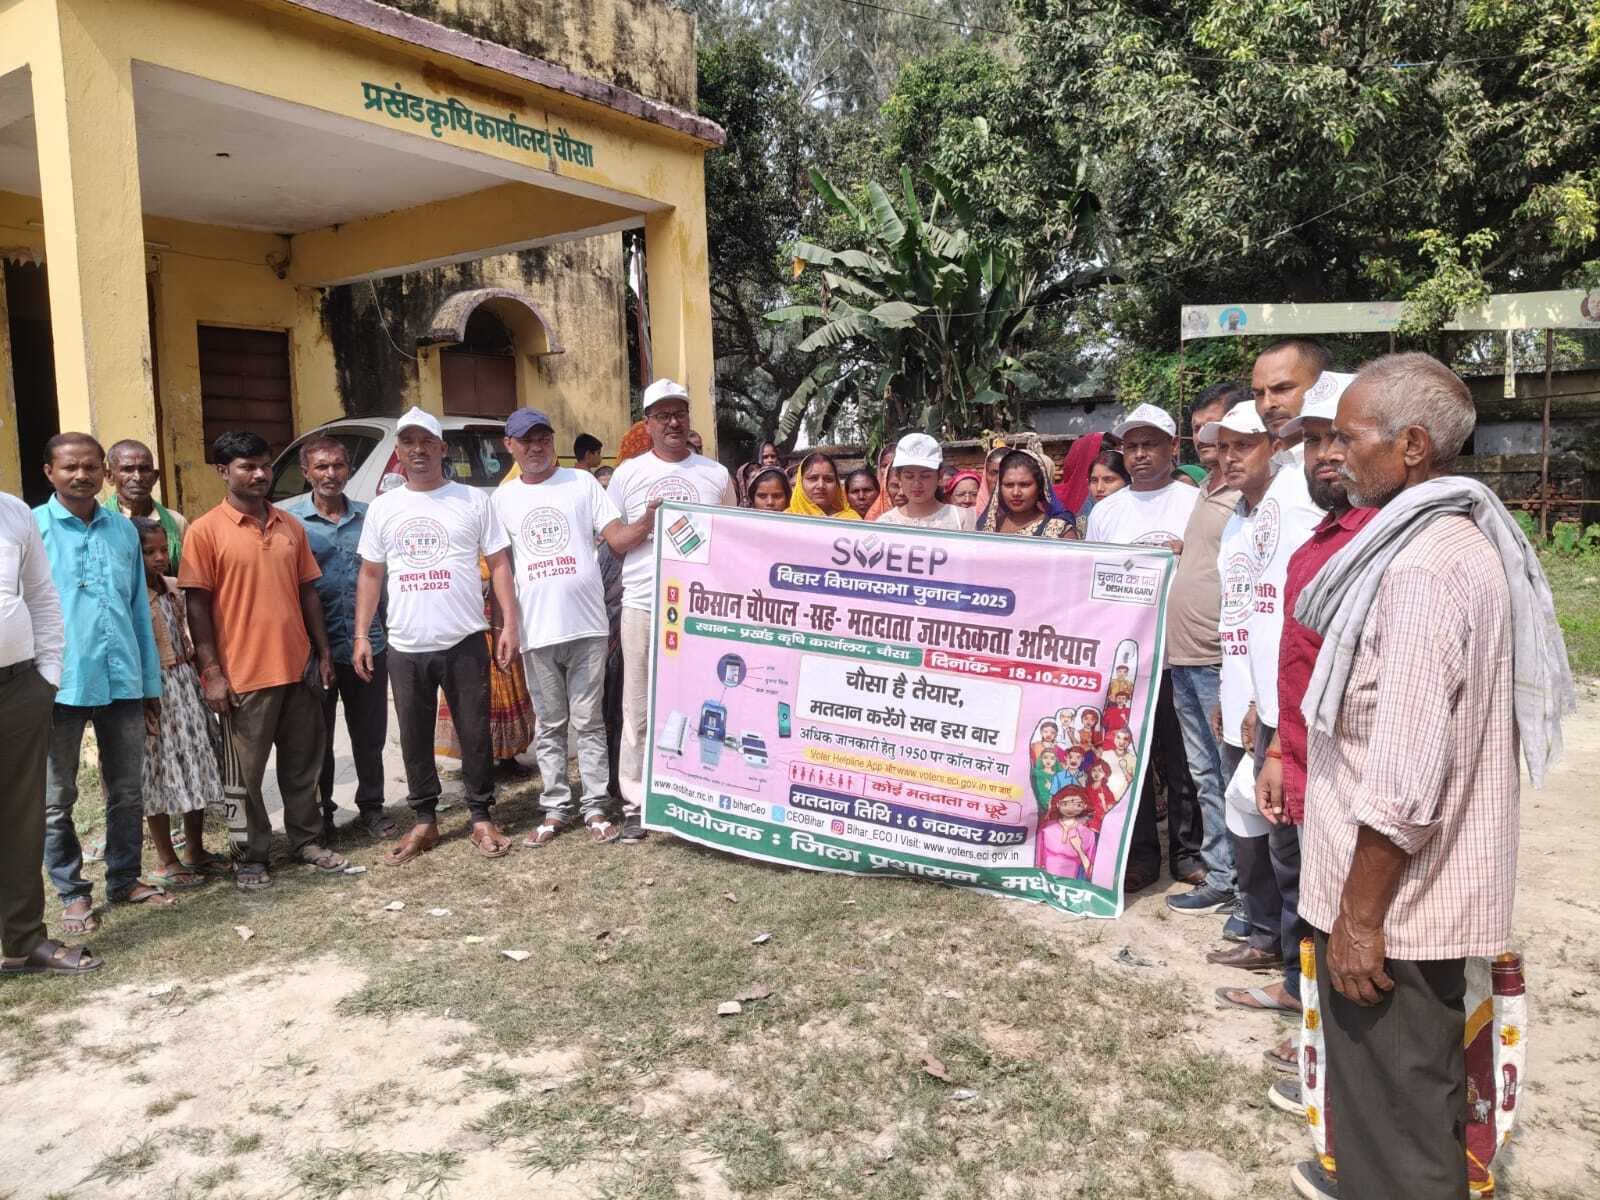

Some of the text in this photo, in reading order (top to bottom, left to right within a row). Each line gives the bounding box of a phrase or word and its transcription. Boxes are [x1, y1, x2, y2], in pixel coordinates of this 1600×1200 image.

[425, 97, 473, 137] कृषि
[552, 127, 594, 167] चौसा
[831, 535, 948, 575] SWEEP
[688, 581, 744, 619] किसान
[746, 588, 800, 627] चौपाल
[847, 608, 915, 642] मतदाता
[1016, 624, 1101, 668] अभियान
[846, 666, 965, 709] चौसा है तैयार,
[1007, 666, 1098, 690] 18.10.2025
[809, 699, 1001, 746] मतदान करेंगे सब इस बार
[799, 726, 832, 745] अधिक
[834, 733, 880, 753] जानकारी
[880, 738, 897, 761] हेतु
[899, 745, 928, 761] 1950
[929, 750, 946, 763] पर
[946, 752, 974, 769] कॉल
[995, 761, 1011, 777] या
[732, 798, 767, 816] biharCeo
[786, 809, 826, 828] CEOBihar
[792, 791, 851, 815] मतदान
[853, 798, 893, 823] तिथि
[907, 816, 918, 828] 6
[987, 830, 1025, 844] 2025
[663, 803, 765, 841] आयोजक
[789, 830, 862, 864] जिला
